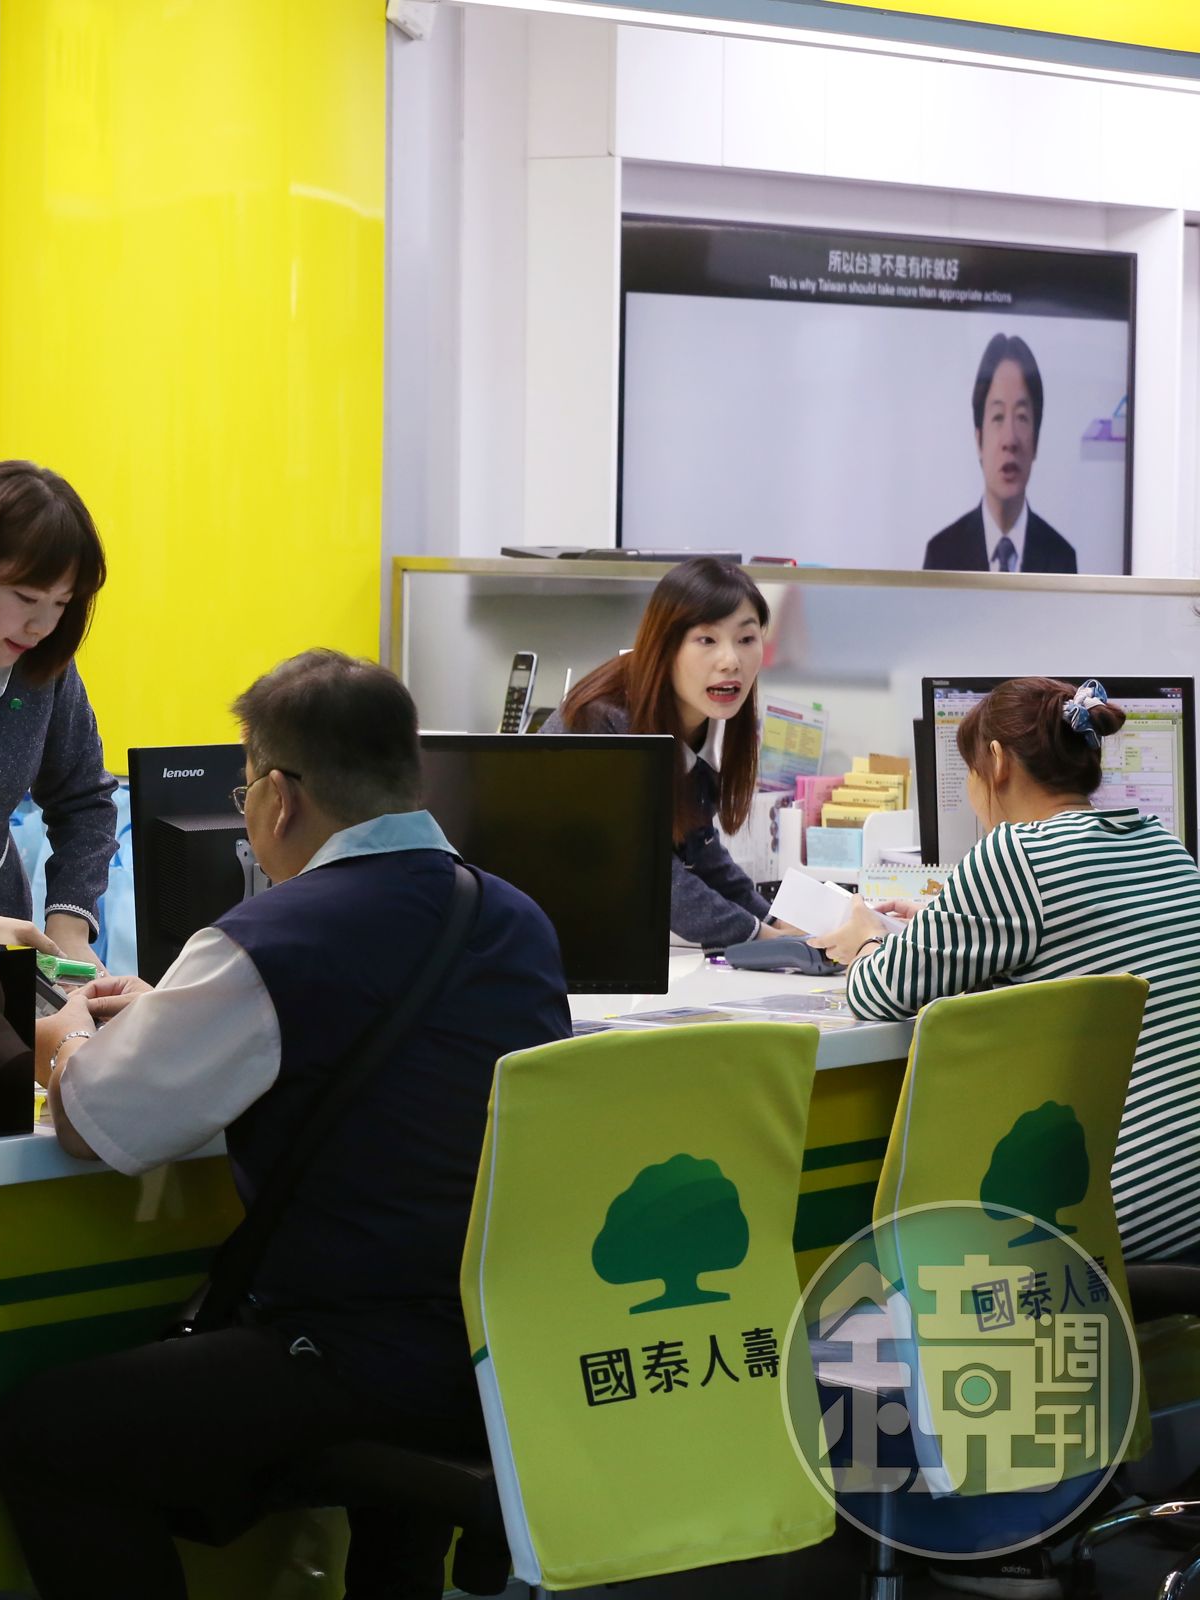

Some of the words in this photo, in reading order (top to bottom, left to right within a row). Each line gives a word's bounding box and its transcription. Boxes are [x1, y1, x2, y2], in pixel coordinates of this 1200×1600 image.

[769, 275, 788, 289] This
[789, 277, 798, 290] is
[799, 278, 817, 294] why
[818, 278, 847, 293] Taiwan
[848, 280, 877, 295] should
[878, 282, 895, 296] take
[896, 286, 917, 298] more
[918, 286, 936, 298] than
[938, 288, 983, 303] appropriate
[984, 290, 1012, 303] actions
[162, 767, 205, 778] lenovo
[971, 1255, 1110, 1332] 國泰人壽
[579, 1327, 780, 1407] 國泰人壽
